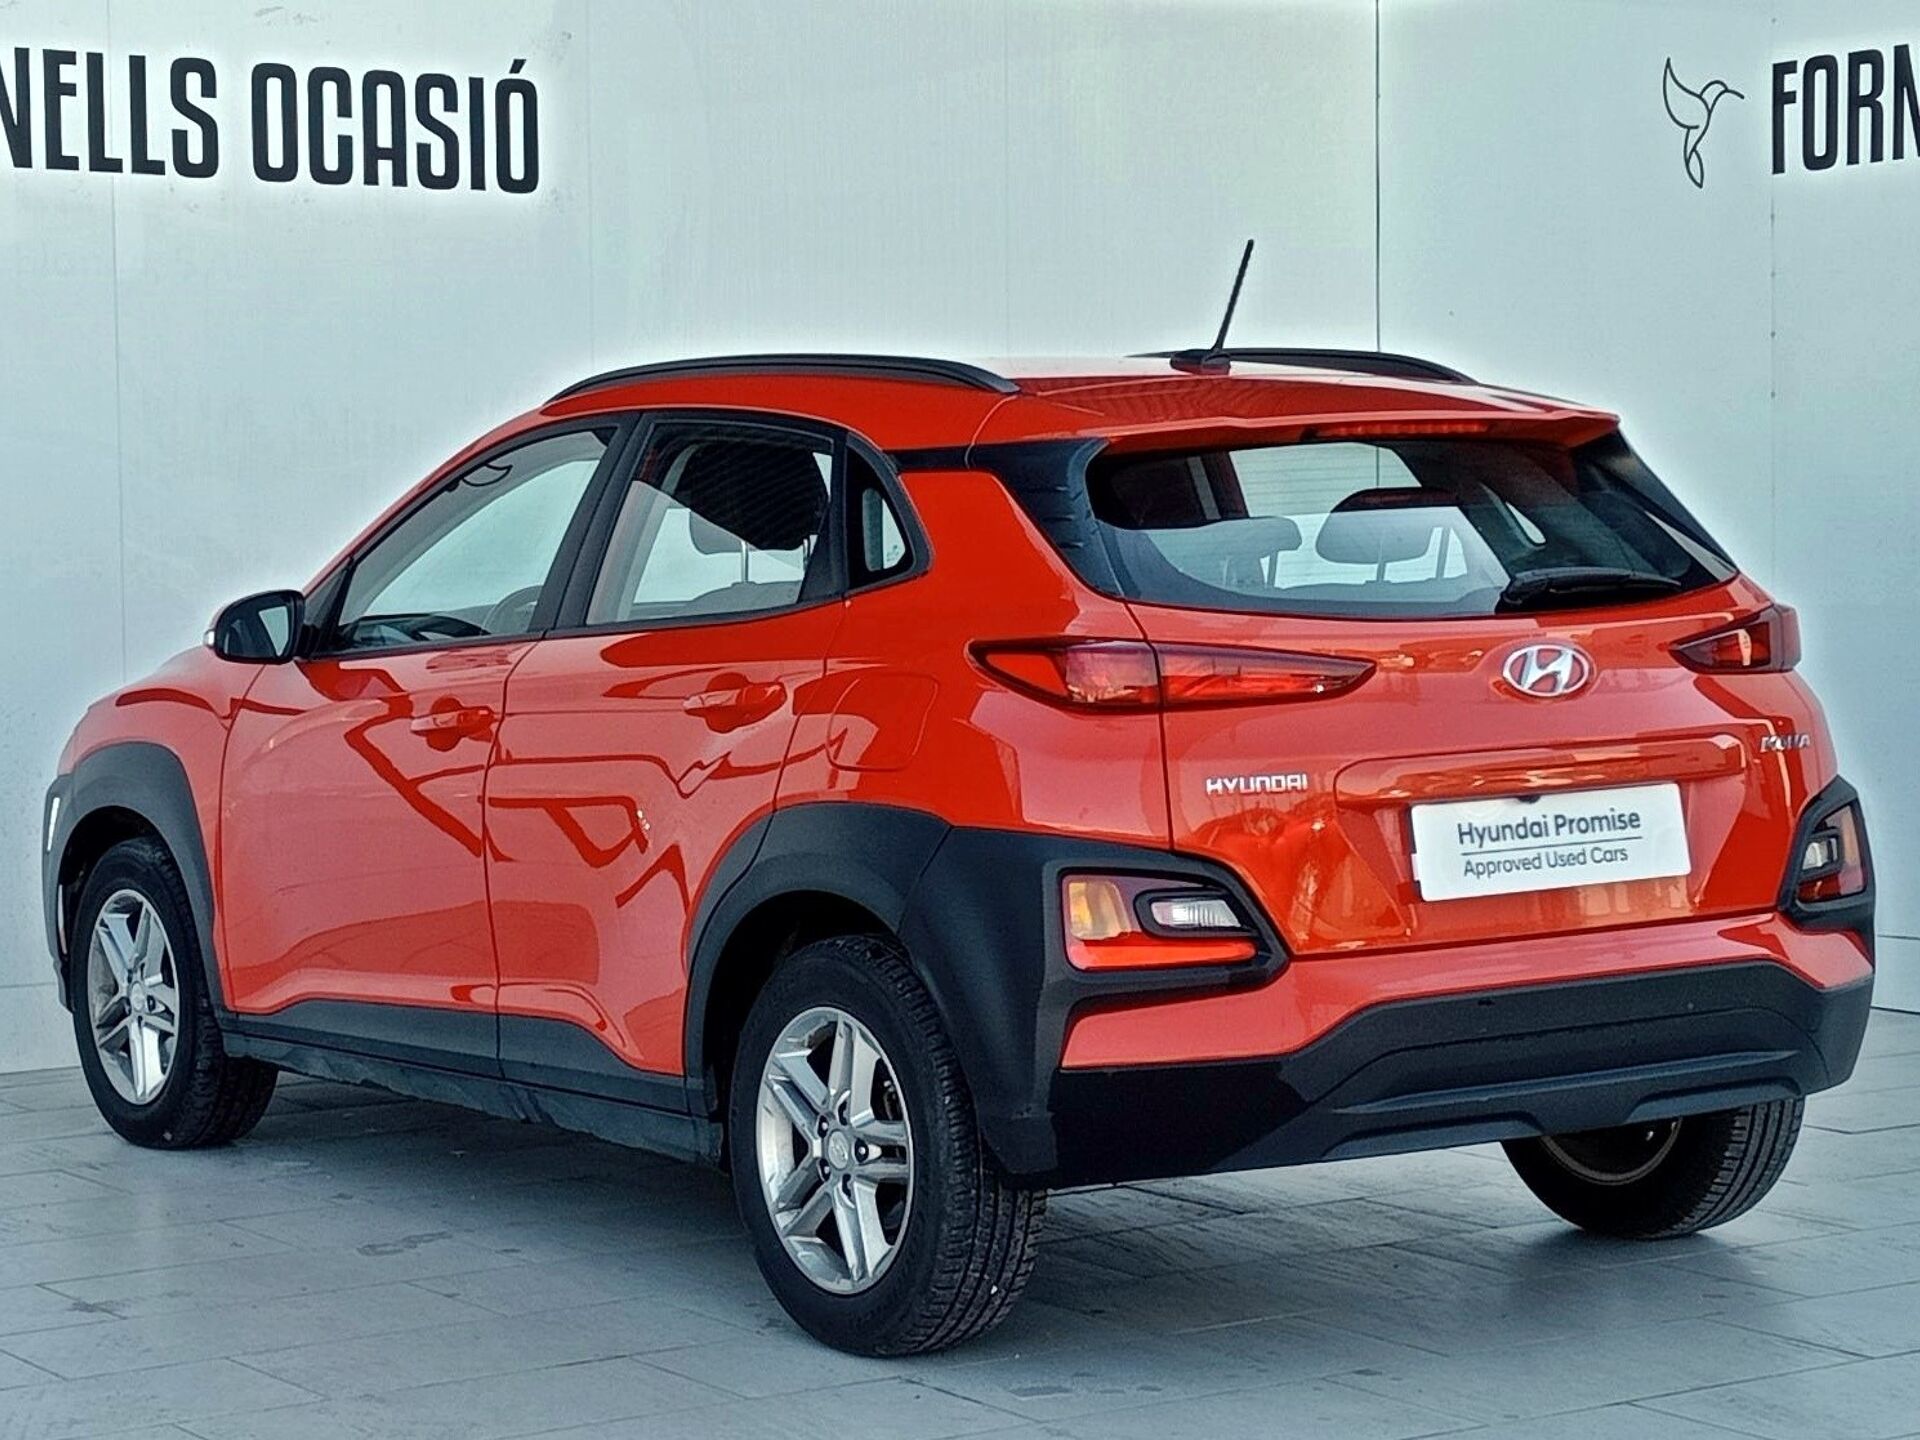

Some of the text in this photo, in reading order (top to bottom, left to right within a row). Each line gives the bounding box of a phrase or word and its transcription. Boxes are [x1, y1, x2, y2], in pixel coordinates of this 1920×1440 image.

[251, 58, 540, 194] OCASIÓ
[1206, 773, 1308, 795] HYUNDAI
[1457, 808, 1641, 848] Hyundai Promise
[1463, 845, 1629, 878] Approved Used Cars
